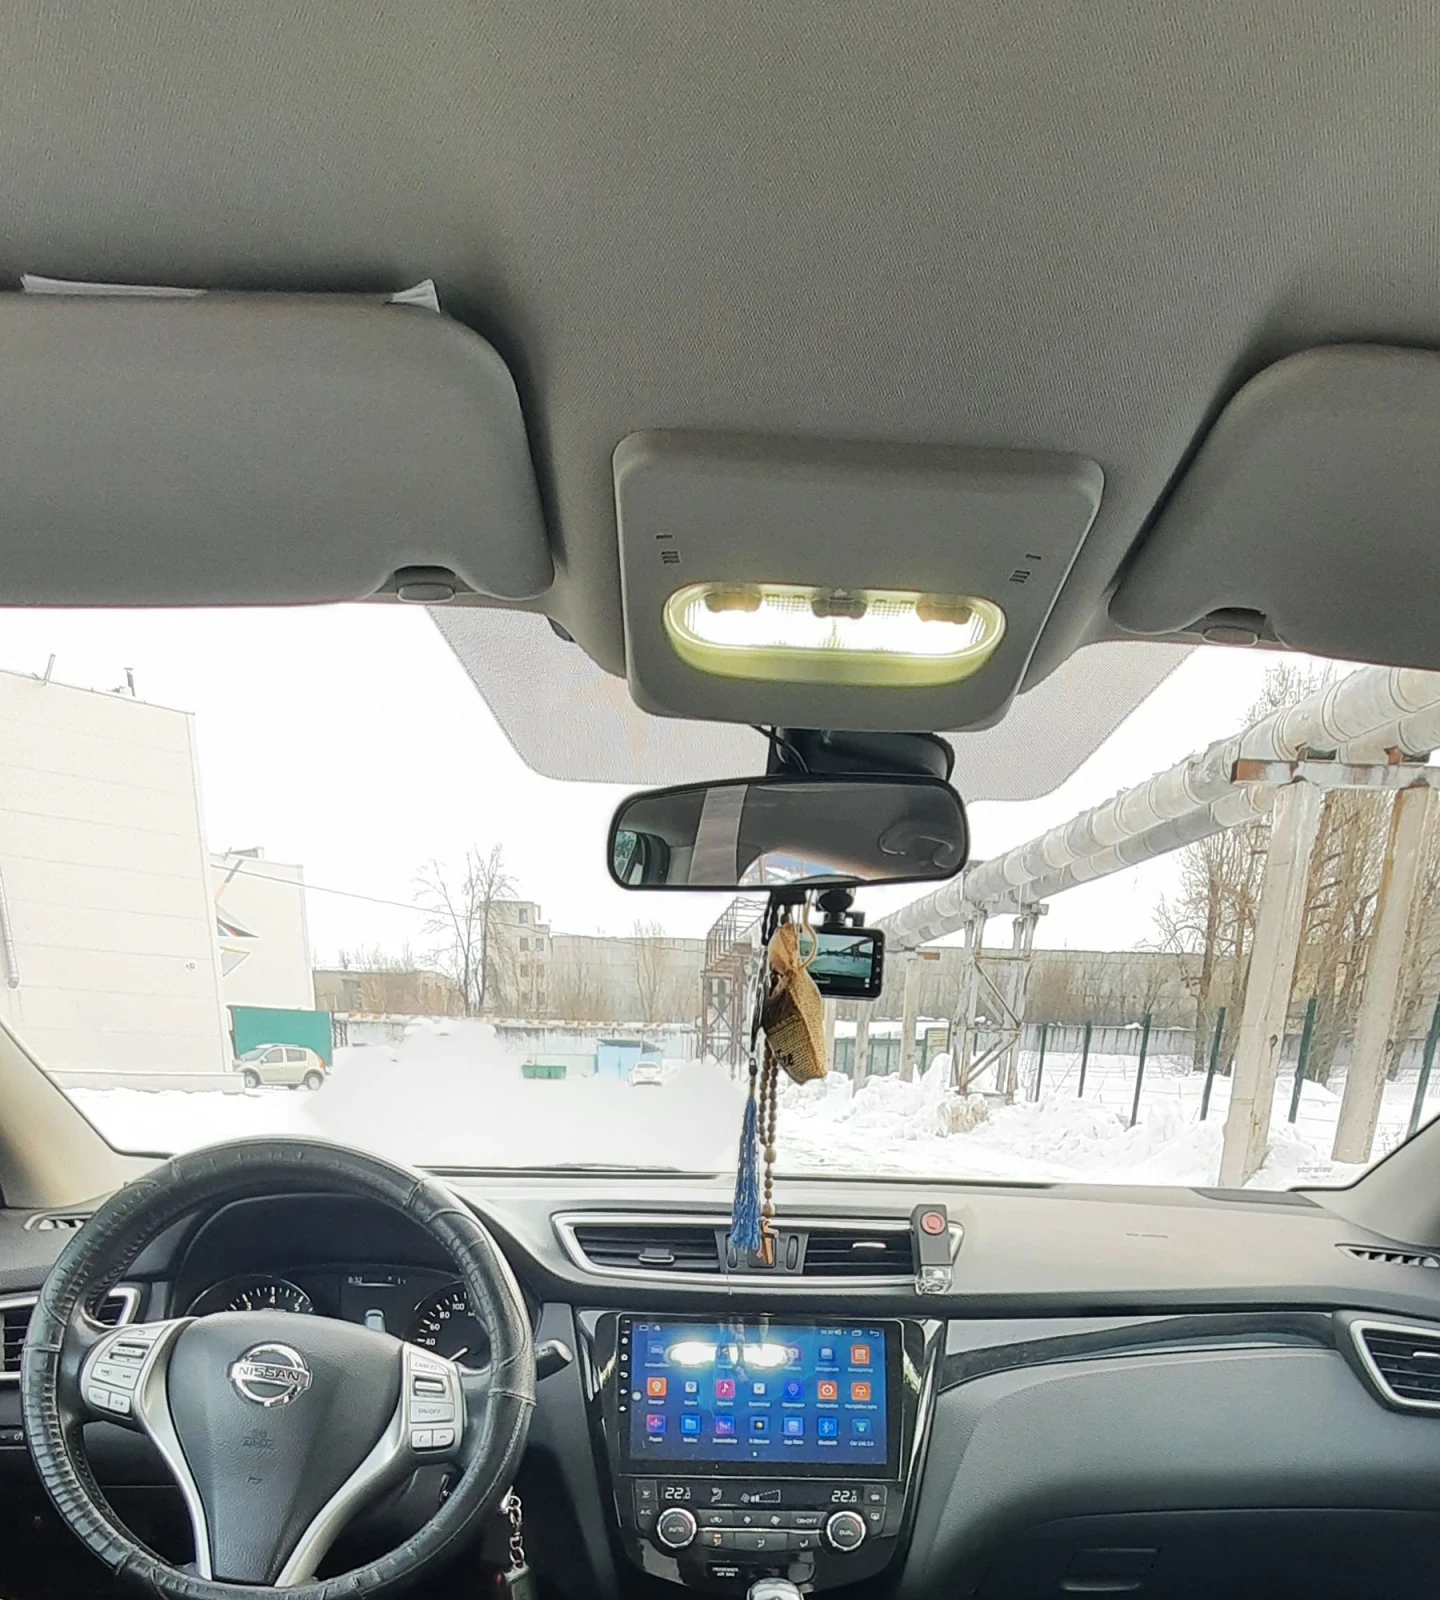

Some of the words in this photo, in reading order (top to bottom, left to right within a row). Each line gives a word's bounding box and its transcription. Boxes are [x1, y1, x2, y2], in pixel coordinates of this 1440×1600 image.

[269, 1295, 276, 1304] 4
[246, 1301, 252, 1311] 3
[294, 1302, 300, 1312] 5
[452, 1302, 465, 1311] 100
[439, 1311, 450, 1319] 80
[429, 1323, 440, 1331] 60
[425, 1337, 436, 1346] 40
[414, 1362, 438, 1371] CANCEL
[238, 1364, 301, 1382] NISSAN
